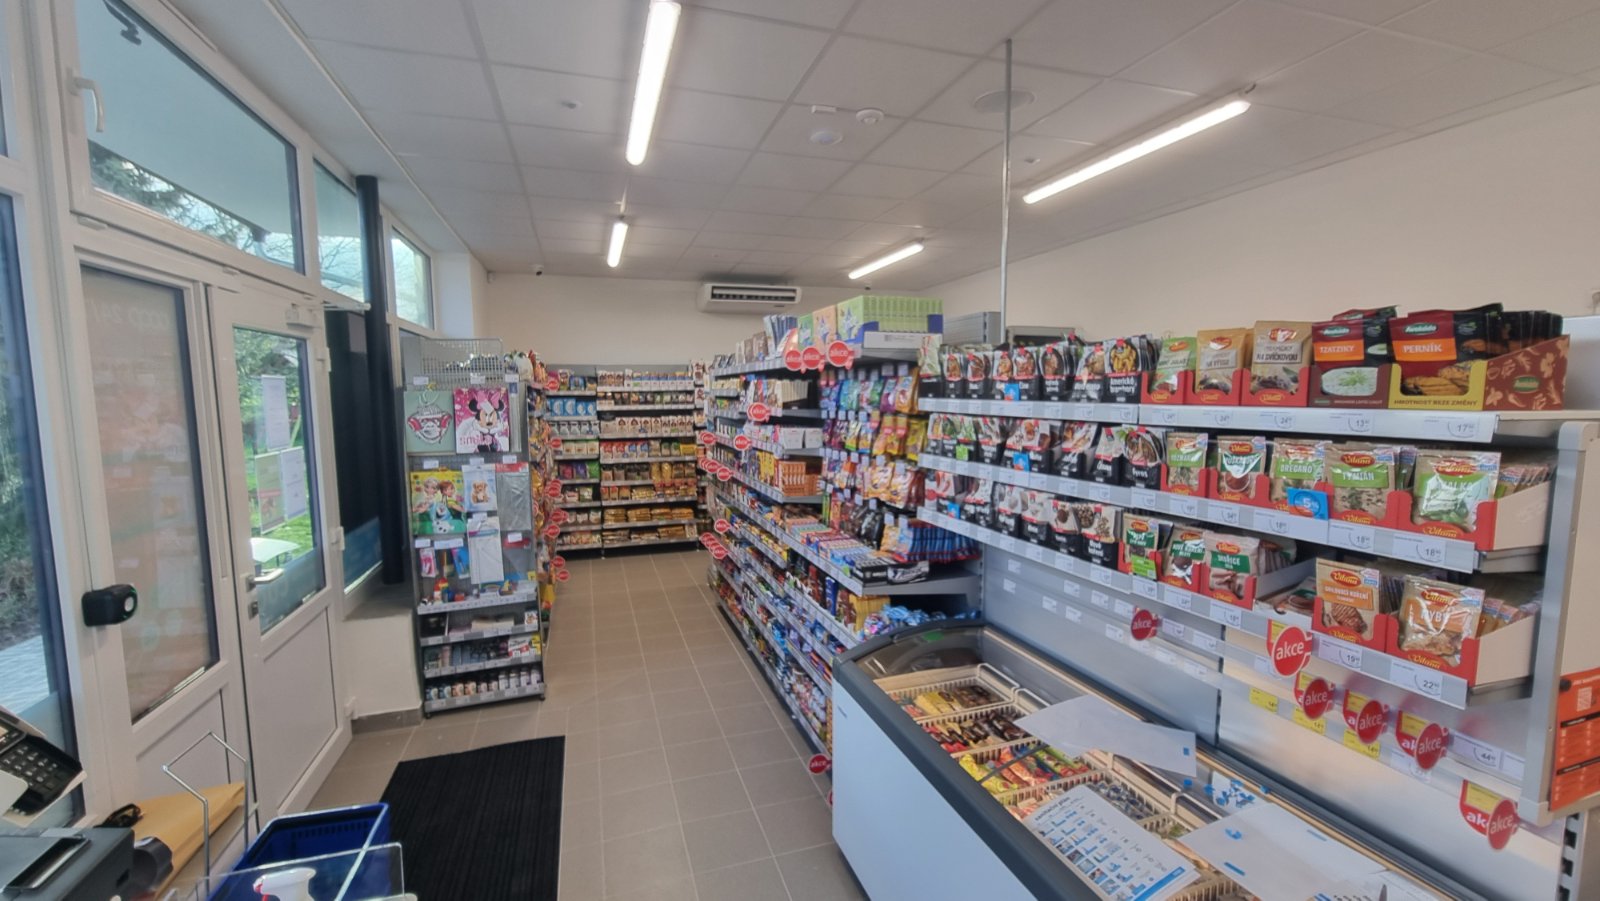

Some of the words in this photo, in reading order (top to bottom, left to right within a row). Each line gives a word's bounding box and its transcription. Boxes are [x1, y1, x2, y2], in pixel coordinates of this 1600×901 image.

[1402, 343, 1443, 354] PERNÍK
[1450, 398, 1478, 406] ZMĚNY
[1344, 455, 1372, 465] Vitana
[1280, 463, 1313, 474] OREGANO
[1342, 470, 1375, 482] TYMIÁN
[1344, 514, 1372, 526] Vitana
[1426, 527, 1458, 539] Vitana
[1333, 571, 1358, 585] Vitana
[1132, 617, 1153, 631] akce
[1275, 640, 1305, 661] akce
[1411, 653, 1442, 670] Vitana
[1305, 690, 1328, 707] akce
[1358, 713, 1383, 731] akce
[1418, 736, 1443, 755] akce
[1466, 810, 1488, 829] ak
[1490, 813, 1514, 835] akce
